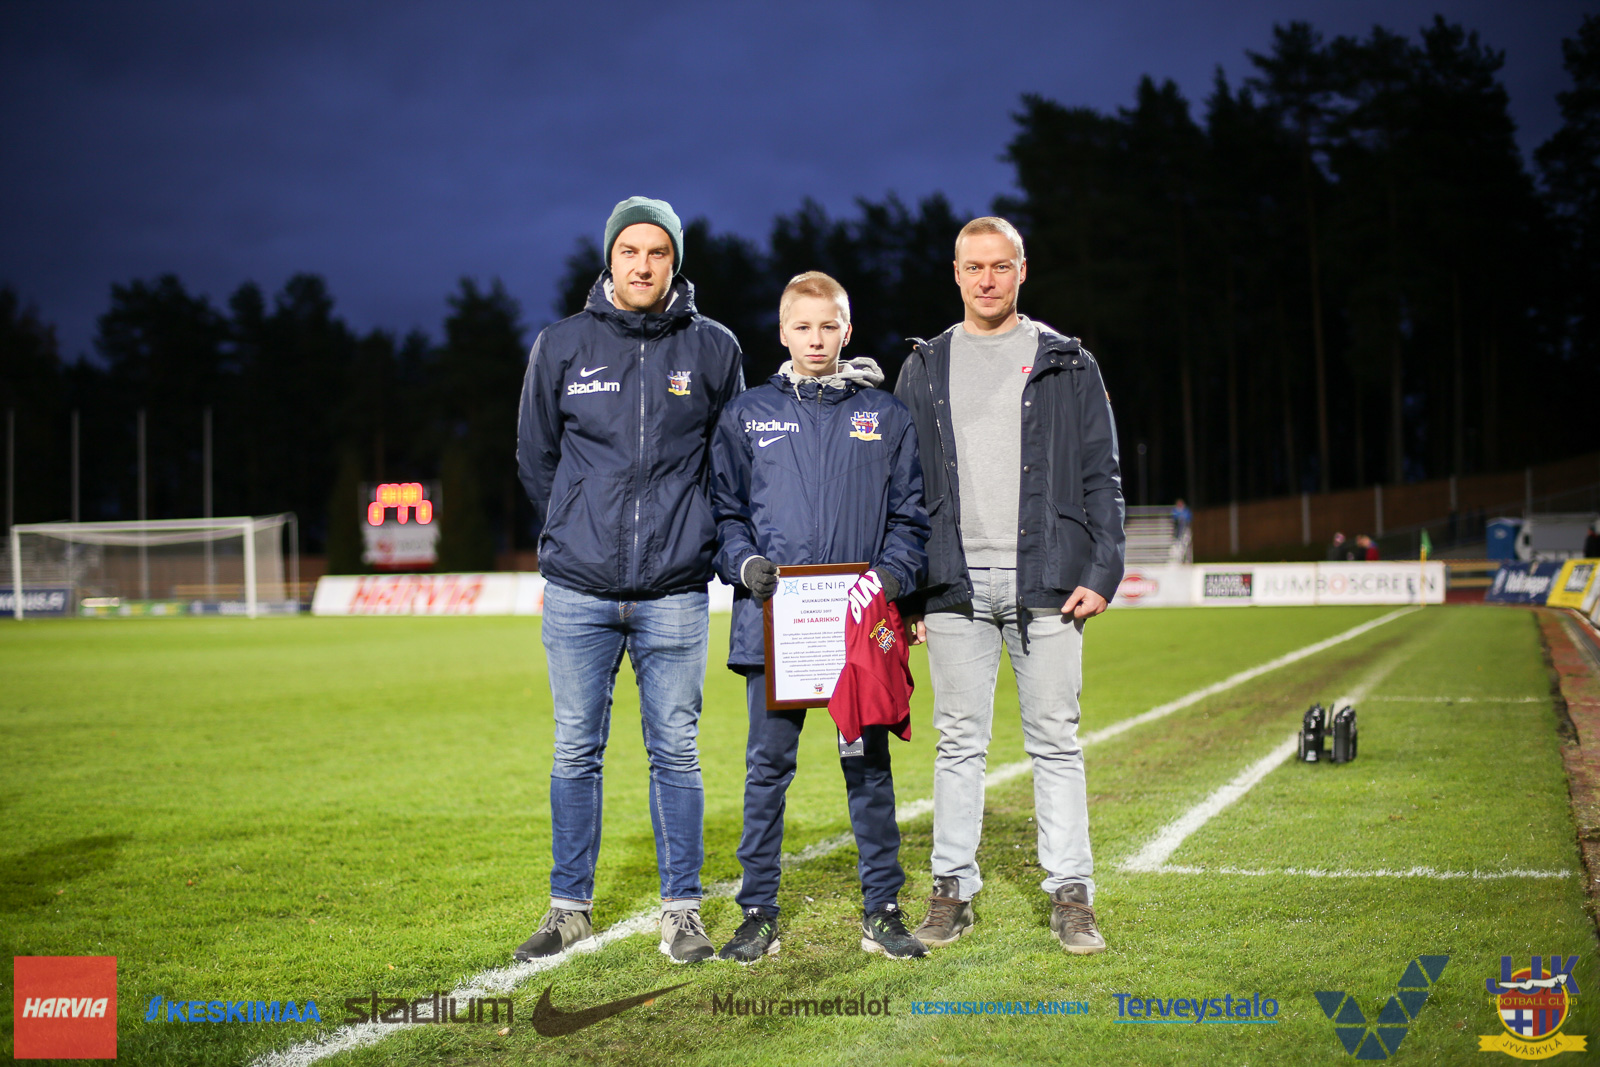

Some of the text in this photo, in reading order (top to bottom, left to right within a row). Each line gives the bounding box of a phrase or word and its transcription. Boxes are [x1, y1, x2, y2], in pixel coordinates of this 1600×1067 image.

[567, 379, 620, 395] stadium
[744, 419, 800, 432] stadium
[801, 581, 846, 590] ELENIA
[807, 616, 840, 624] SAARIKKO
